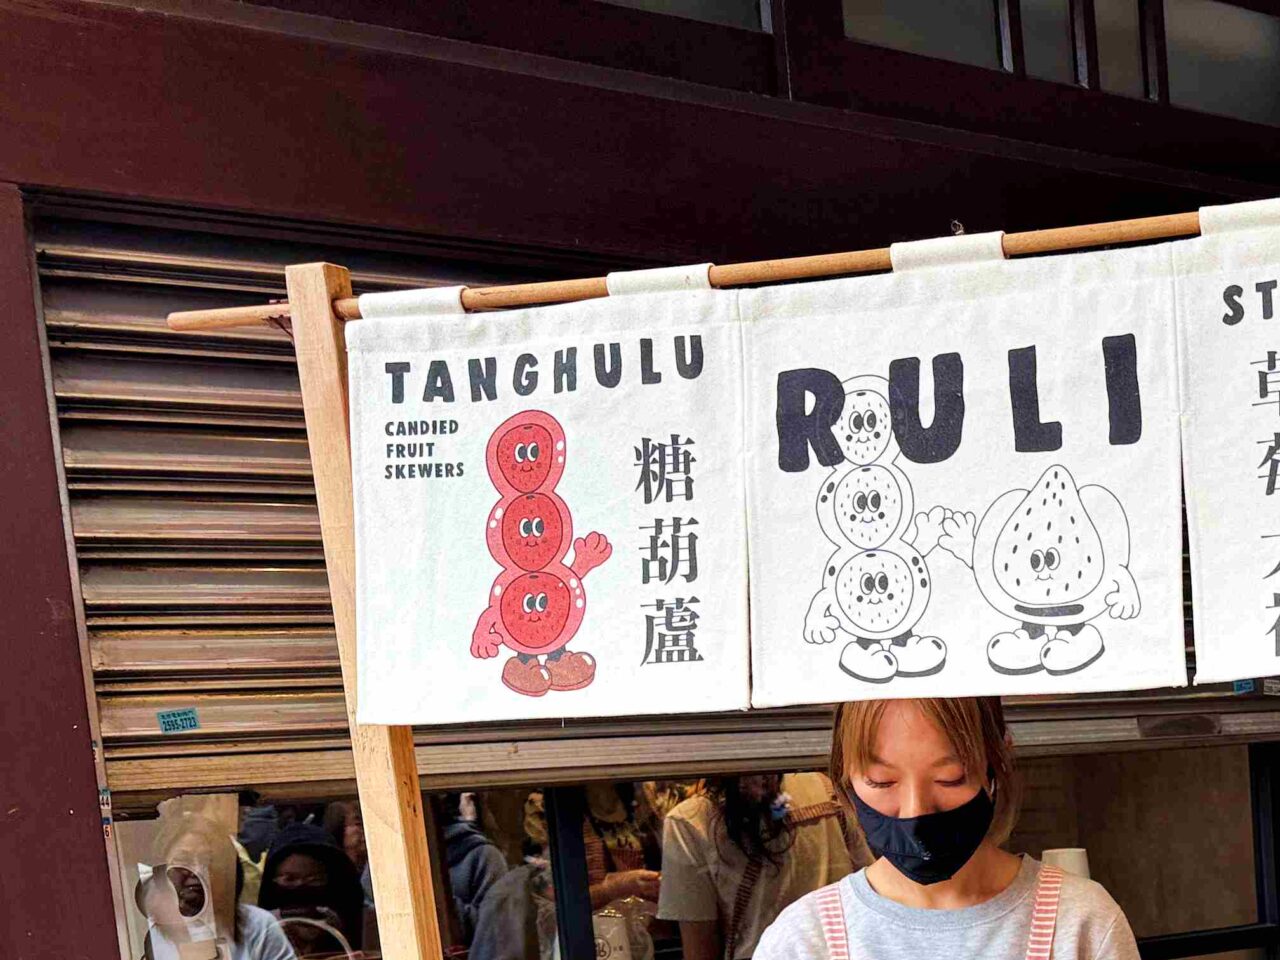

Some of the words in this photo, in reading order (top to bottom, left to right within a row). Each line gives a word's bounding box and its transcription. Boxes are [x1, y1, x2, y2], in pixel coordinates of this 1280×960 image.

[385, 334, 704, 404] TANGHULU
[776, 333, 1142, 473] RULI
[385, 419, 459, 437] CANDIED
[384, 461, 465, 480] SKEWERS
[386, 442, 435, 459] FRUIT
[633, 433, 705, 667] 糖葫蘆
